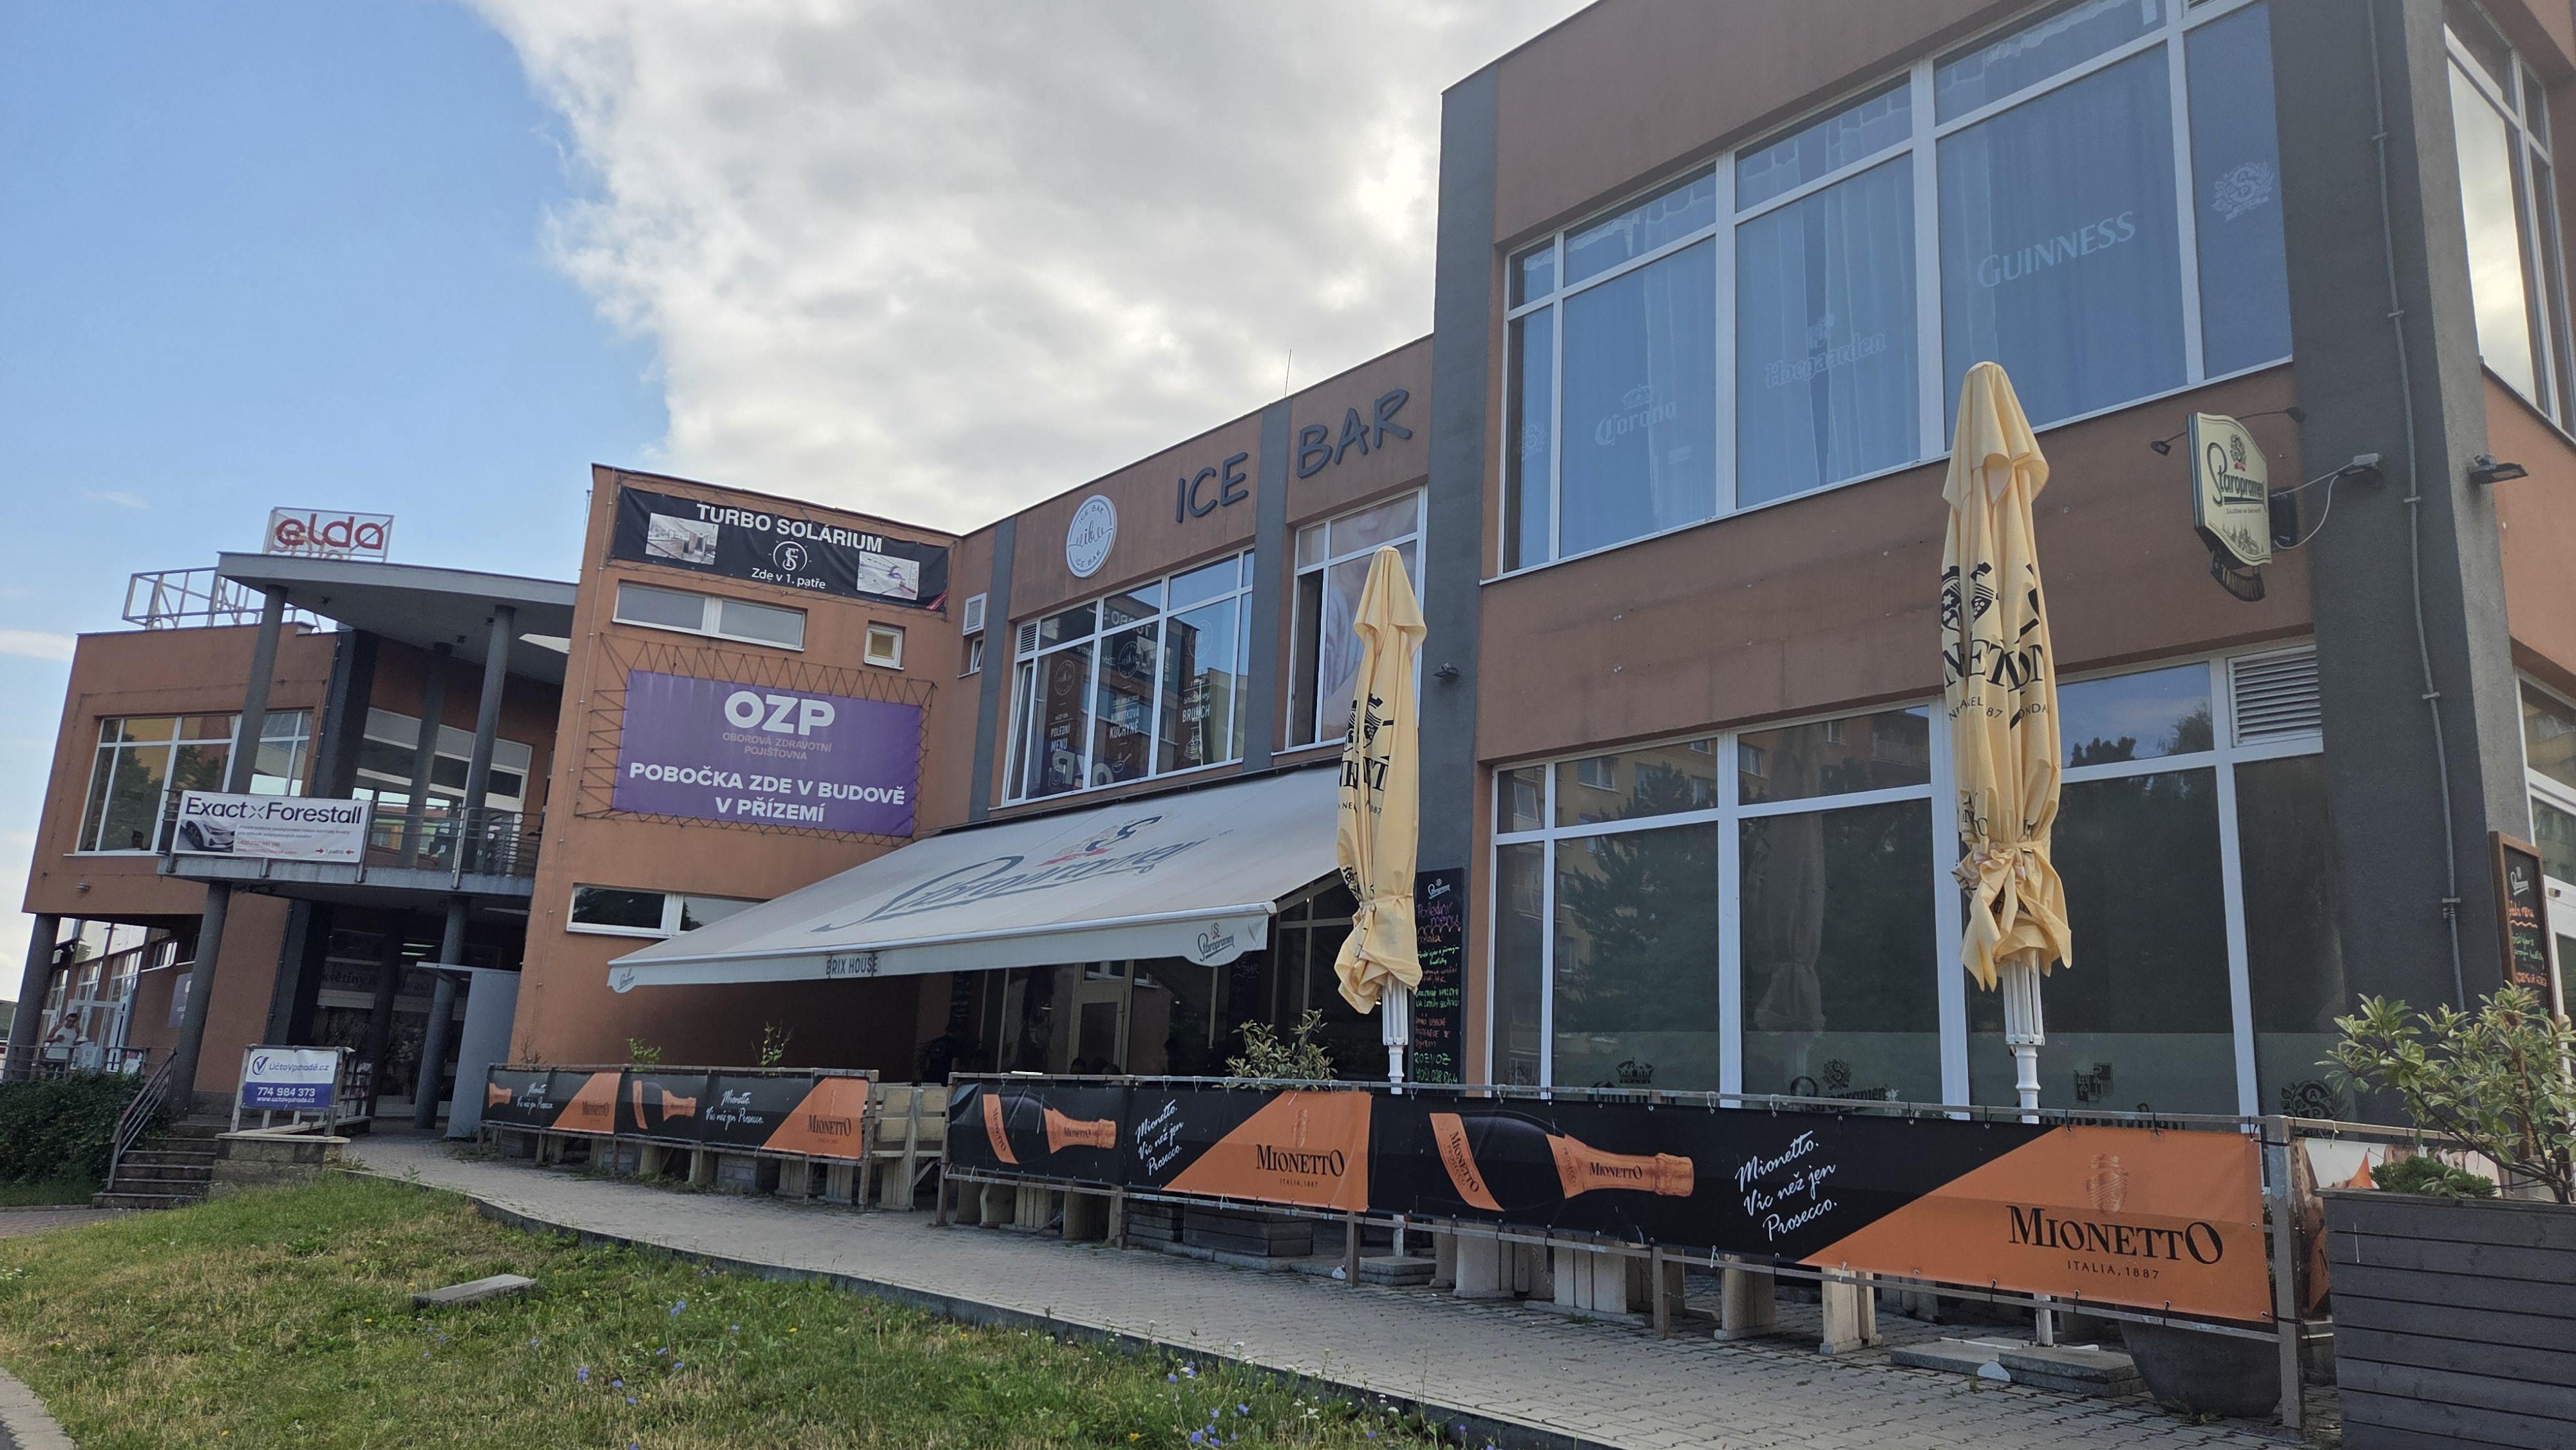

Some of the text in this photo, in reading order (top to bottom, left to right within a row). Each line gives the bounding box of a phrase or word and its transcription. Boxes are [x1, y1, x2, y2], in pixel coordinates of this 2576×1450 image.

[1977, 211, 2136, 288] GUINNESS
[1764, 332, 1886, 389] Hoegaarden
[1595, 400, 1677, 446] Corona
[1176, 388, 1413, 523] ICE BAR
[2206, 442, 2267, 507] Staropramen
[276, 513, 384, 550] elda
[697, 503, 772, 532] TURBO
[1078, 505, 1104, 524] ICE BAR
[752, 567, 826, 590] Zde v 1. patře
[724, 691, 835, 736] OZP
[1182, 704, 1210, 722] BRUNCH
[722, 732, 832, 753] OBOROVÁ ZDRAVOTNÍ
[1051, 737, 1067, 753] MENU
[629, 762, 905, 805] POBOČKA ZDE V BUDOVĚ
[185, 797, 247, 818] Exact
[265, 802, 362, 824] Forestall
[715, 796, 825, 822] V PŘÍZEMÍ
[826, 956, 878, 975] BRIX HOUSE
[258, 1087, 315, 1097] 774 984 373
[807, 1115, 852, 1137] MIONETTO
[1256, 1144, 1345, 1178] MIONETTO
[1450, 1131, 1480, 1192] MIONETTO
[1589, 1162, 1643, 1180] MIONETTO
[1734, 1130, 1819, 1192] Mionetto.
[1777, 1171, 1805, 1200] než
[1808, 1164, 1836, 1200] jen
[1762, 1199, 1837, 1241] Prosecco.
[2006, 1205, 2223, 1265] MIONETTO
